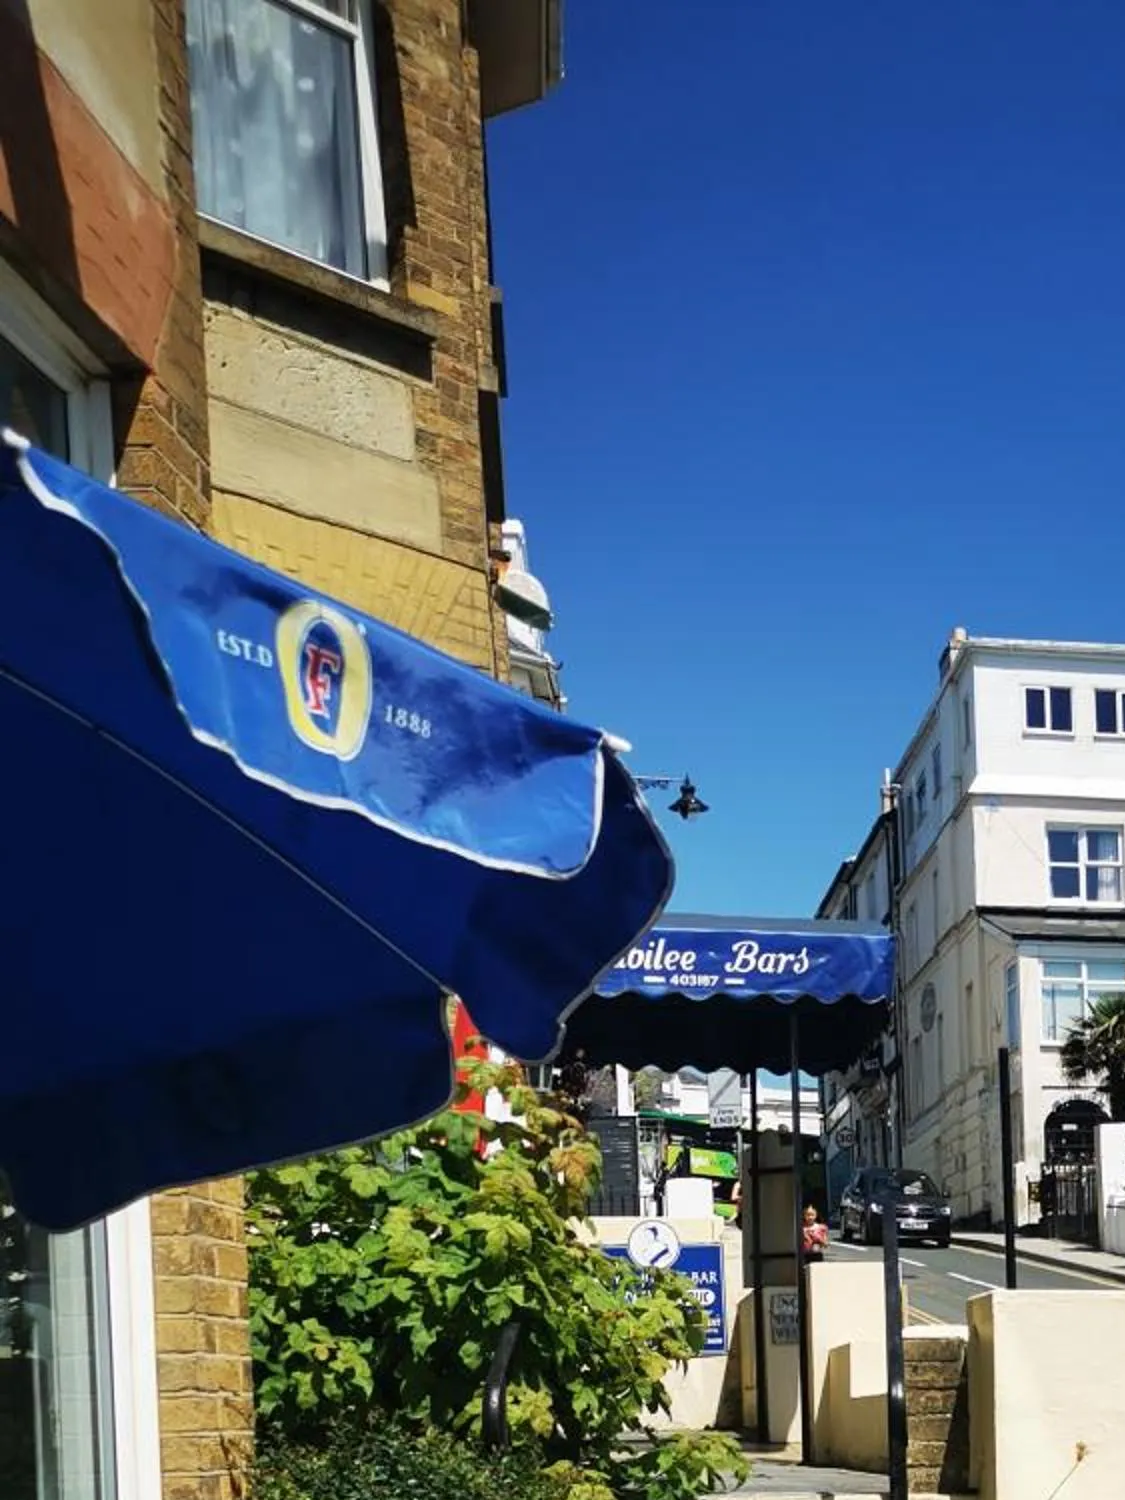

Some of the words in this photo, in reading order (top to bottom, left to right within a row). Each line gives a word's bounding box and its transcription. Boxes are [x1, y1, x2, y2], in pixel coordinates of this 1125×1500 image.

[304, 643, 341, 719] F
[384, 704, 432, 739] 1888
[724, 940, 810, 975] Bars
